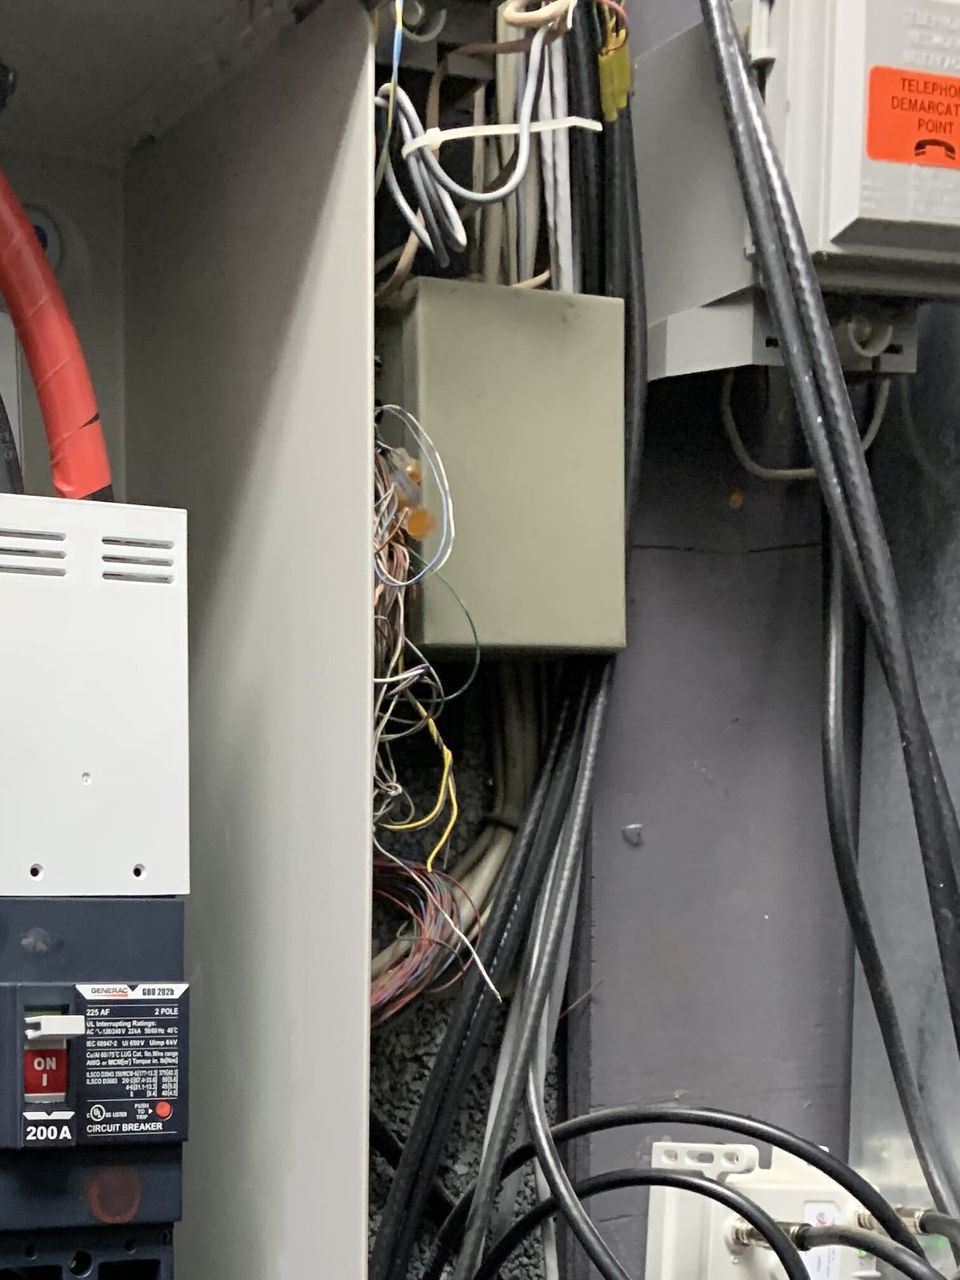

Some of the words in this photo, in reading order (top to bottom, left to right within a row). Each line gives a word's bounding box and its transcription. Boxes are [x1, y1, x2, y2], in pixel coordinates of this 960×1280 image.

[918, 118, 954, 134] POINT
[161, 1007, 178, 1015] POLE
[96, 1020, 131, 1028] Interrupting
[33, 1057, 57, 1070] ON
[86, 1124, 121, 1133] CIRCUIT
[122, 1122, 163, 1132] BREAKER
